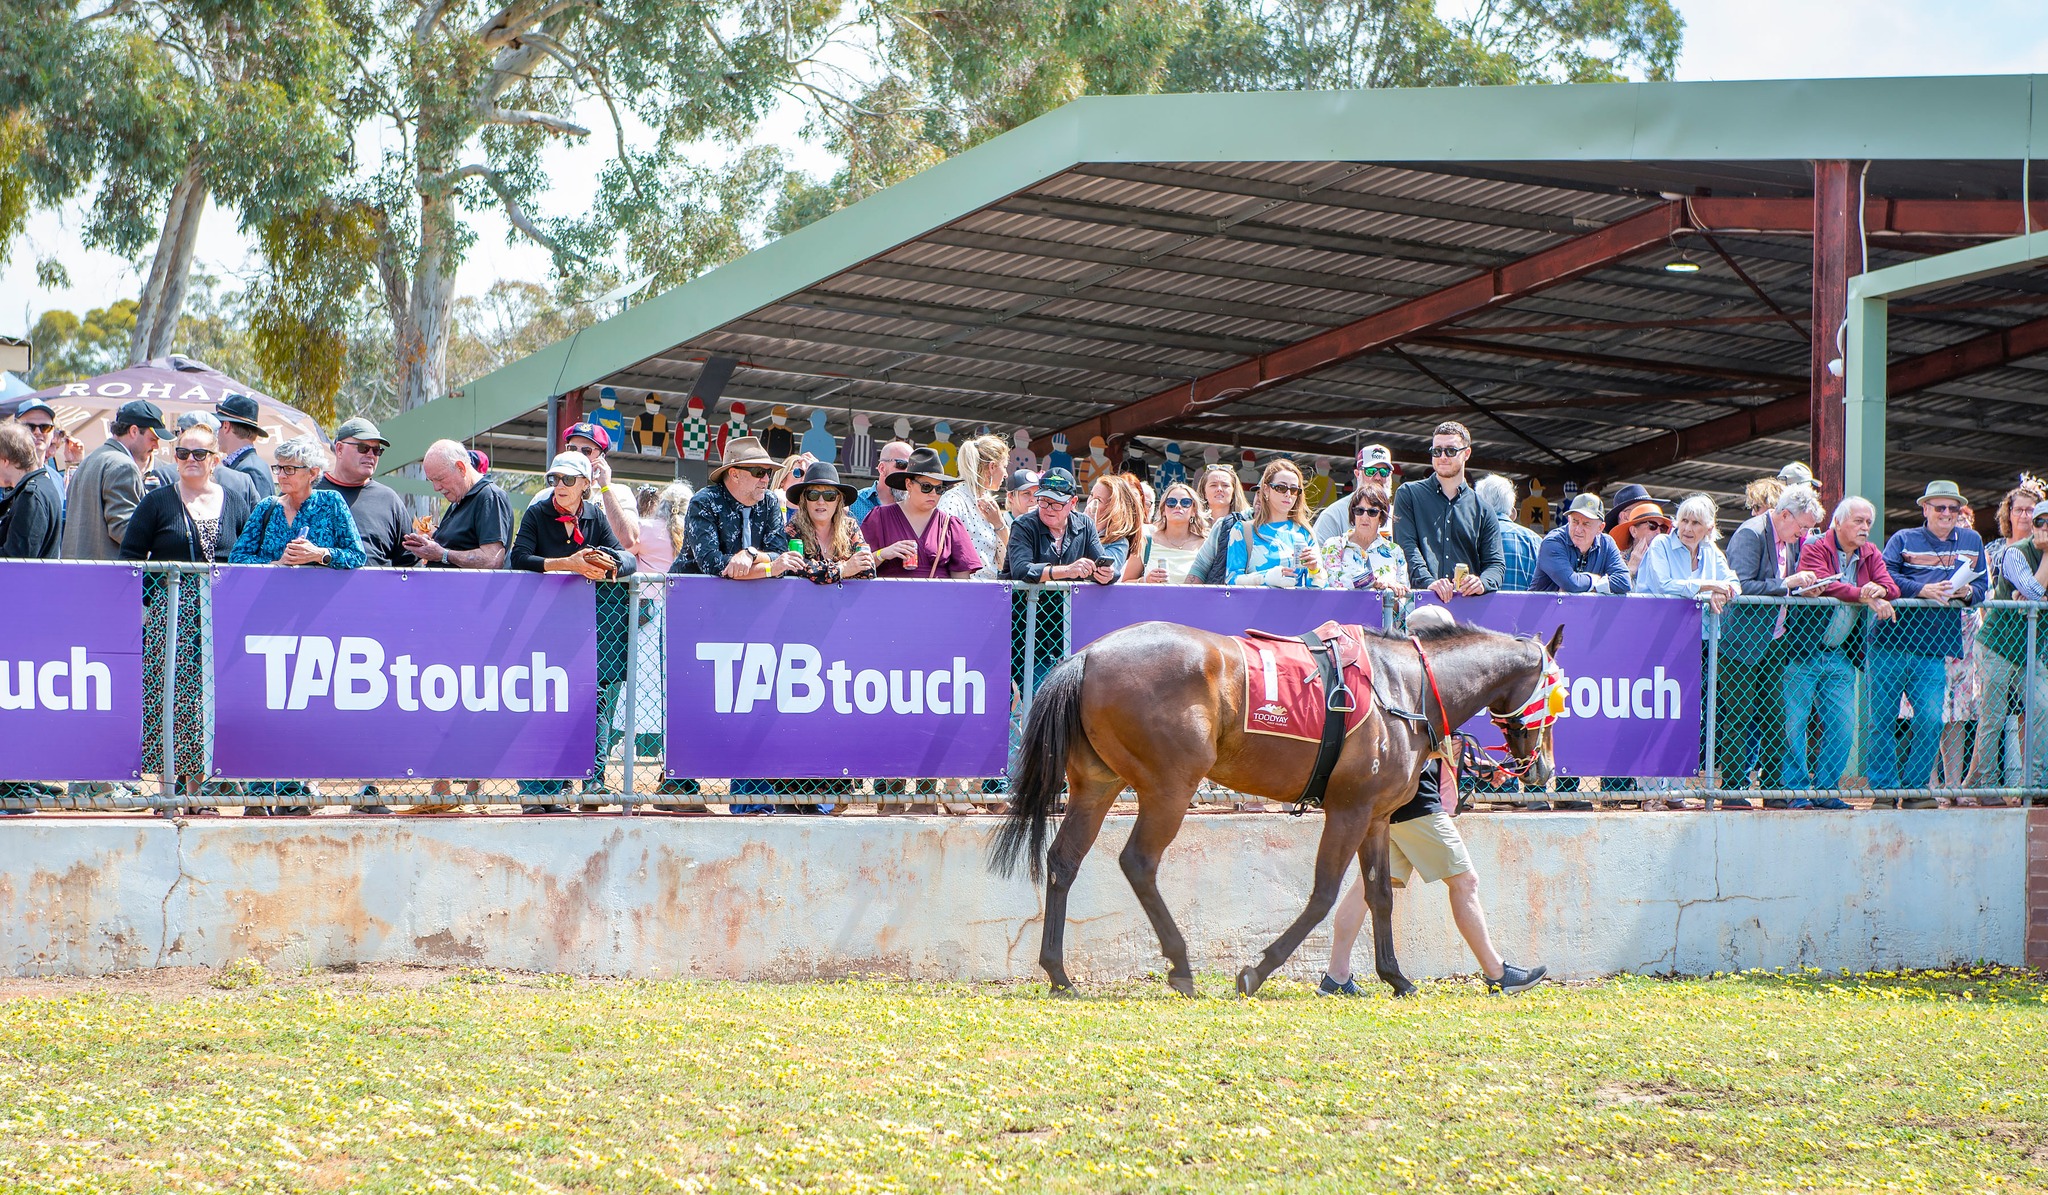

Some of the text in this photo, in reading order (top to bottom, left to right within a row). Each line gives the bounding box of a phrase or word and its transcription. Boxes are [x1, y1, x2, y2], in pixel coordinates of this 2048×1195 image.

[245, 635, 569, 712] TABtouch
[696, 642, 986, 715] TABtouch
[1259, 649, 1278, 702] 1
[1253, 713, 1289, 724] TOODYAY
